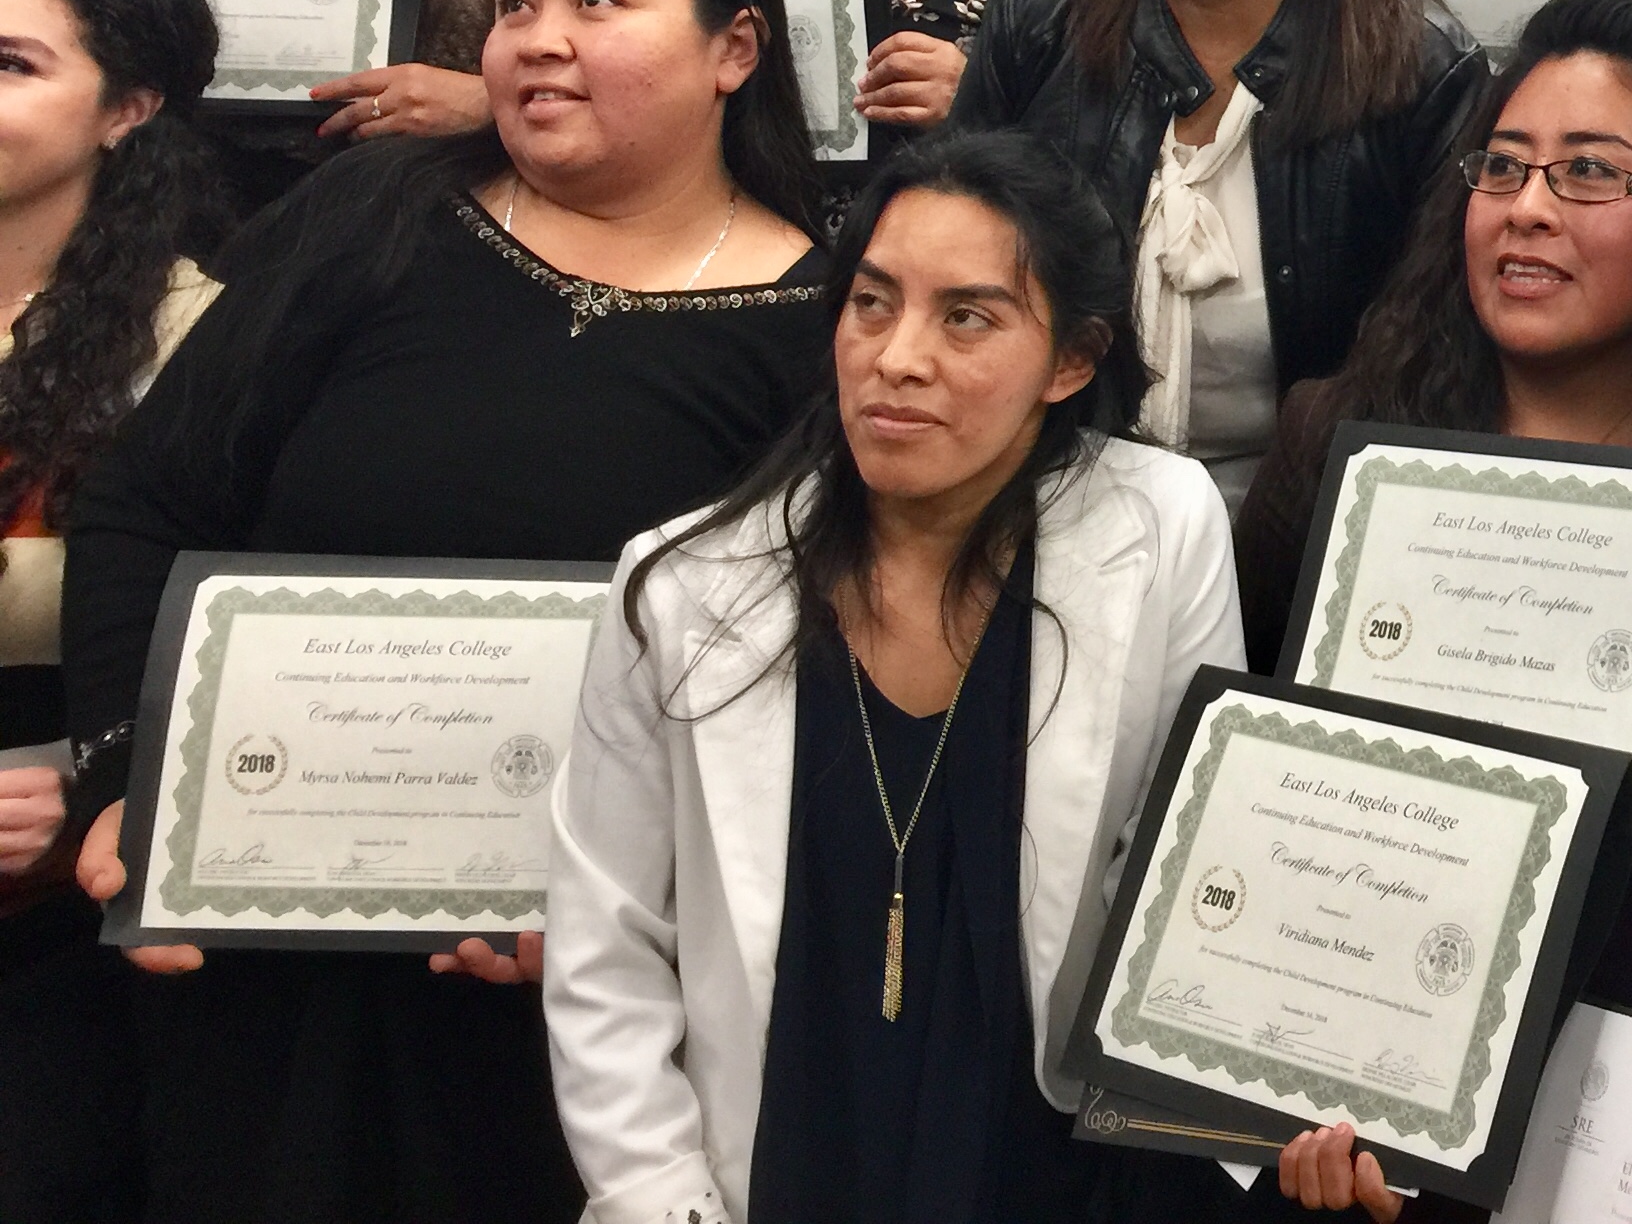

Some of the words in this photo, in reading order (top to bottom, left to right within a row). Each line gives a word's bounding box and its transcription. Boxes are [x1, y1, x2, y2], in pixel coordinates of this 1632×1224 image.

[1432, 512, 1464, 529] East
[1466, 516, 1492, 532] Los
[1495, 520, 1552, 540] Angeles
[1556, 526, 1612, 549] College
[1408, 543, 1454, 559] Continuing
[1456, 548, 1500, 562] Education
[1502, 555, 1521, 564] and
[1522, 556, 1567, 570] Workforce
[1568, 561, 1628, 578] Development
[1432, 575, 1497, 601] Certificate
[1498, 589, 1514, 607] of
[1517, 585, 1592, 616] Completion
[1369, 620, 1404, 642] 2018
[303, 639, 341, 653] East
[344, 639, 374, 653] Los
[378, 640, 443, 658] Angeles
[449, 640, 512, 660] College
[1437, 644, 1472, 659] Gisela
[1474, 649, 1516, 666] Brigido
[1519, 656, 1555, 671] Mazas
[272, 671, 331, 684] Continuing
[333, 672, 385, 682] Education
[387, 673, 408, 683] and
[410, 674, 462, 685] Workforce
[464, 674, 530, 686] Development
[307, 701, 383, 726] Certificate
[384, 708, 403, 729] of
[407, 703, 493, 730] Completion
[237, 754, 275, 772] 2018
[299, 770, 338, 785] Myrsa
[342, 771, 392, 783] Nohemi
[393, 771, 432, 785] Parra
[437, 772, 478, 785] Valdez
[1280, 772, 1312, 793] East
[1314, 781, 1340, 799] Los
[1342, 789, 1398, 814] Angeles
[1403, 802, 1458, 830] College
[1250, 803, 1298, 825] Continuing
[1299, 815, 1343, 834] Education
[1344, 829, 1363, 839] and
[1364, 831, 1410, 851] Workforce
[1410, 843, 1469, 866] Development
[1271, 842, 1334, 876] Certificate
[1335, 867, 1351, 886] of
[1355, 863, 1428, 903] Completion
[1201, 884, 1236, 911] 2018
[1279, 923, 1329, 948] Viridiana
[1330, 938, 1374, 961] Mendez
[1571, 1114, 1595, 1134] SRE
